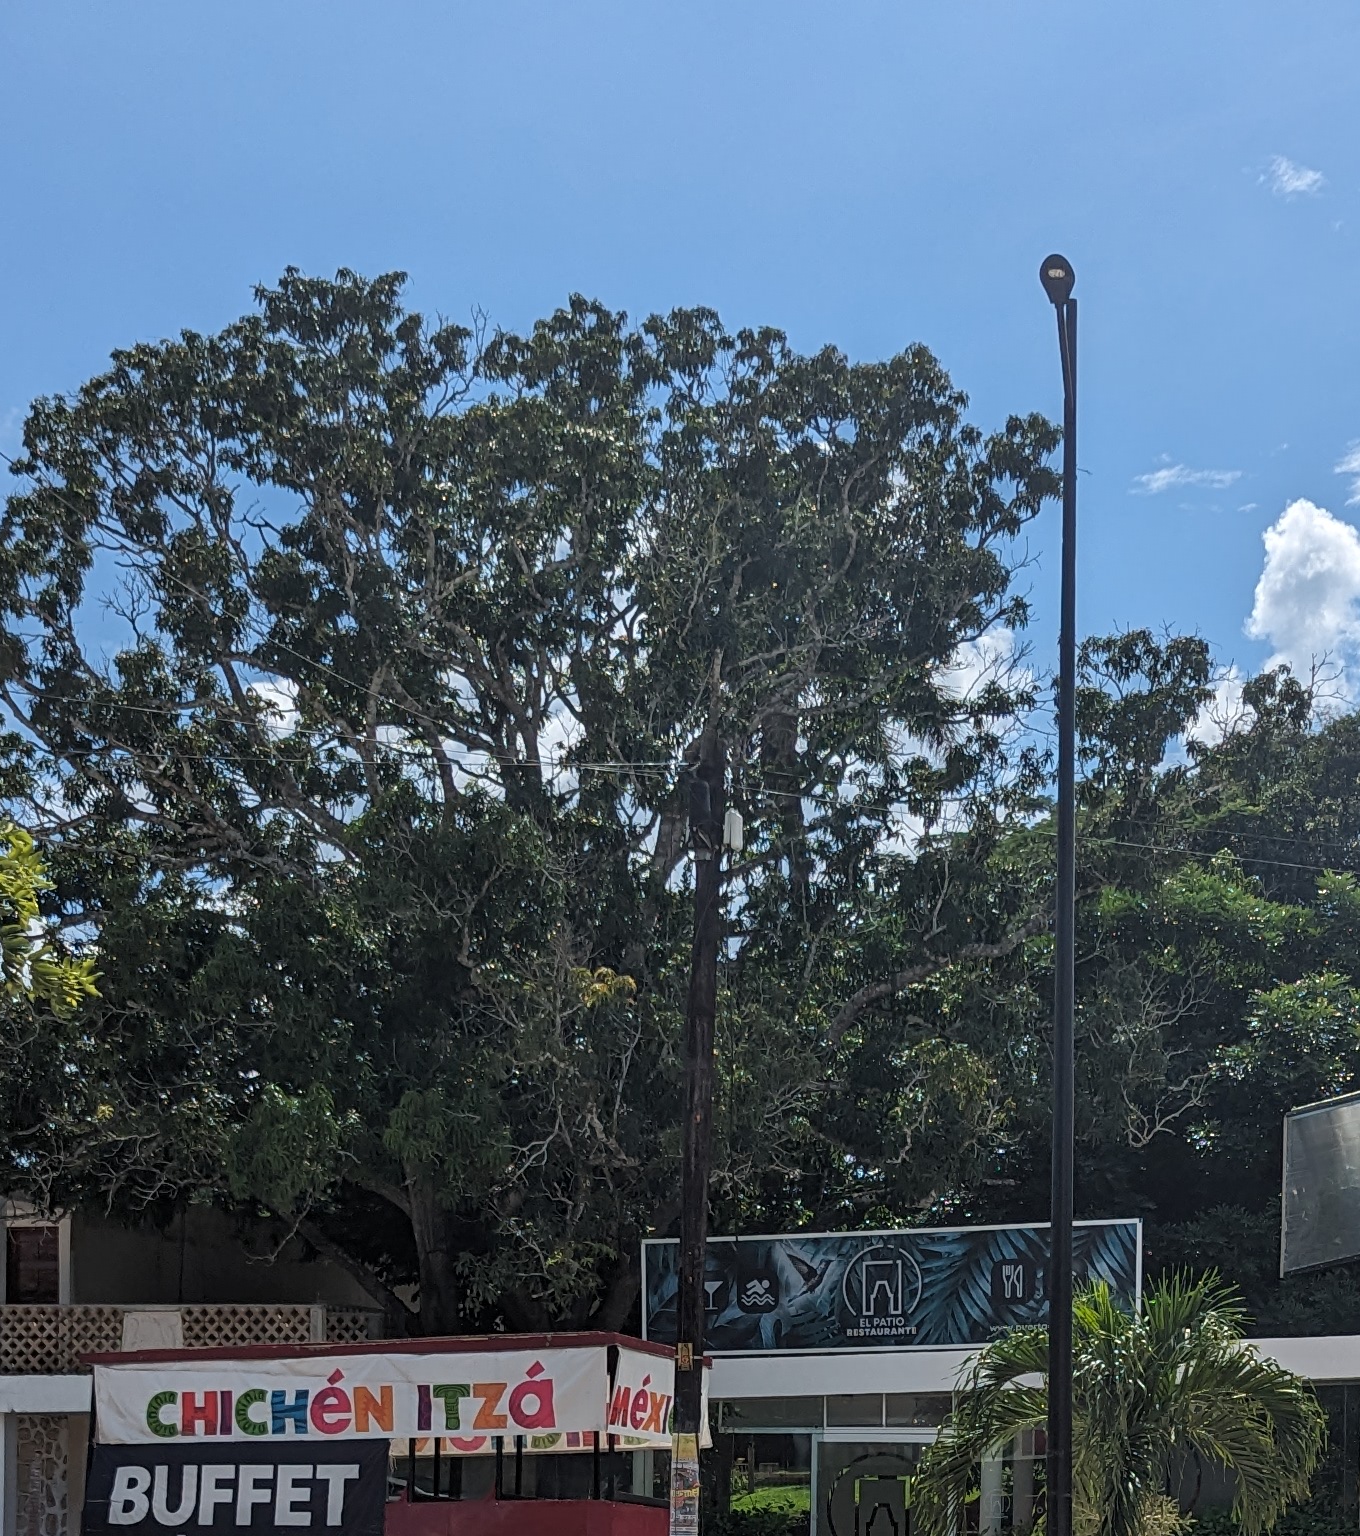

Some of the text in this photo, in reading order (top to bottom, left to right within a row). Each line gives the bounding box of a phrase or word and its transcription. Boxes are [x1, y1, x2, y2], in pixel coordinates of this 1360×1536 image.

[860, 1317, 905, 1327] EL PATIO
[846, 1326, 917, 1337] RESTAURANTE
[108, 1464, 360, 1527] BUFFET
